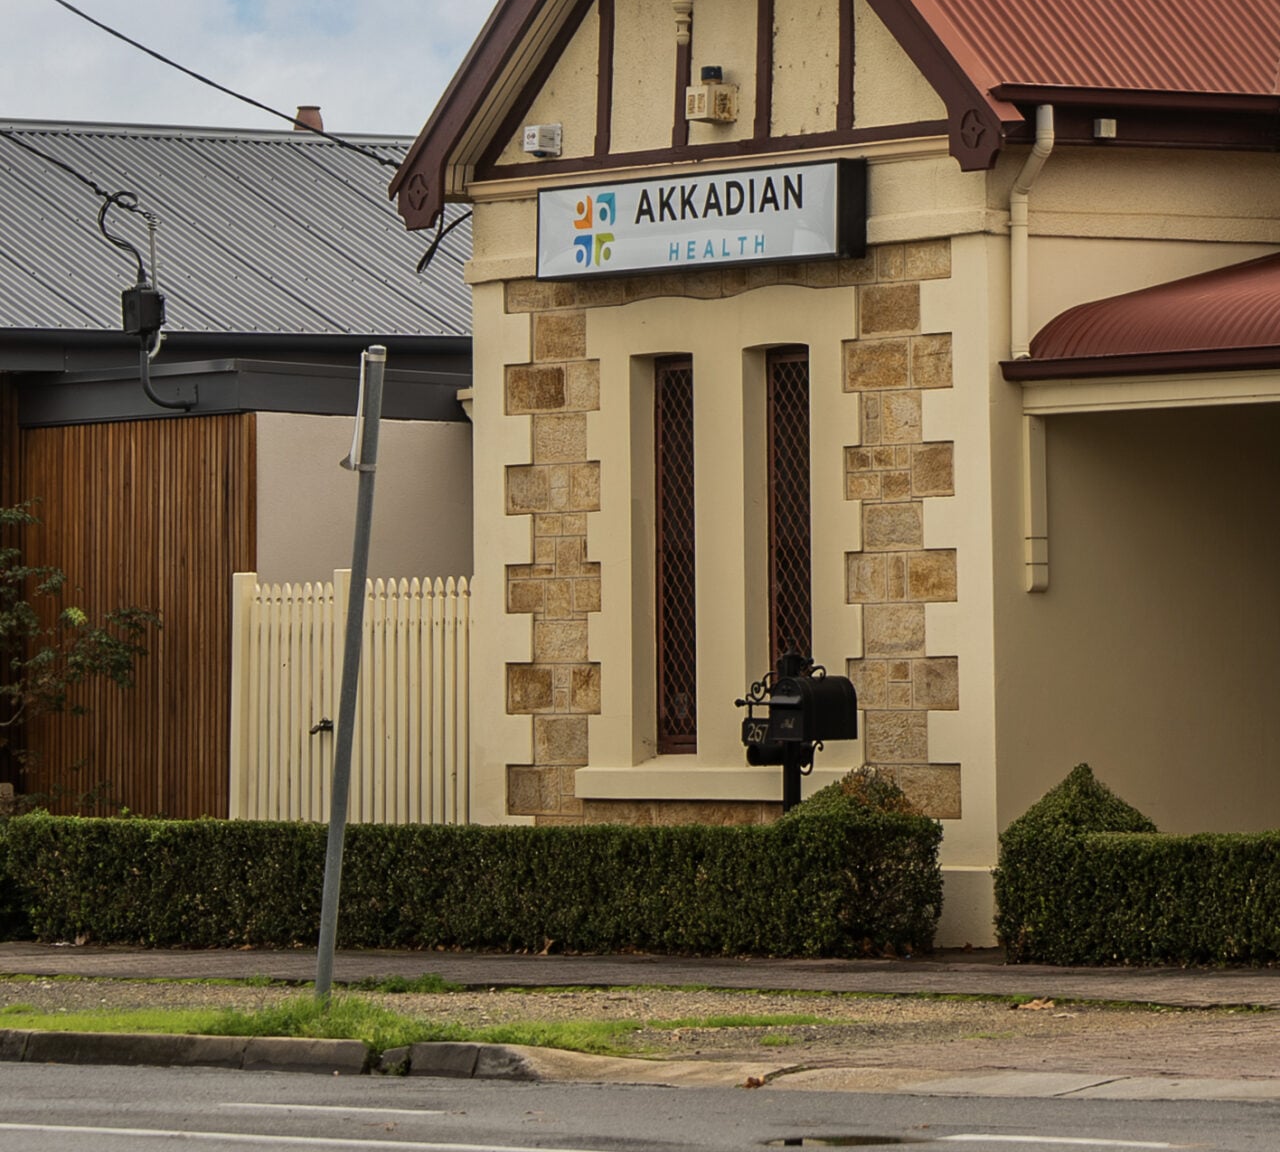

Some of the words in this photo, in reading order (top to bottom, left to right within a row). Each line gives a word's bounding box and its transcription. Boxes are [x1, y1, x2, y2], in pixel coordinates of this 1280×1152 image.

[634, 173, 804, 224] AKKADIAN
[668, 234, 765, 261] HEALTH
[747, 723, 769, 744] 267
